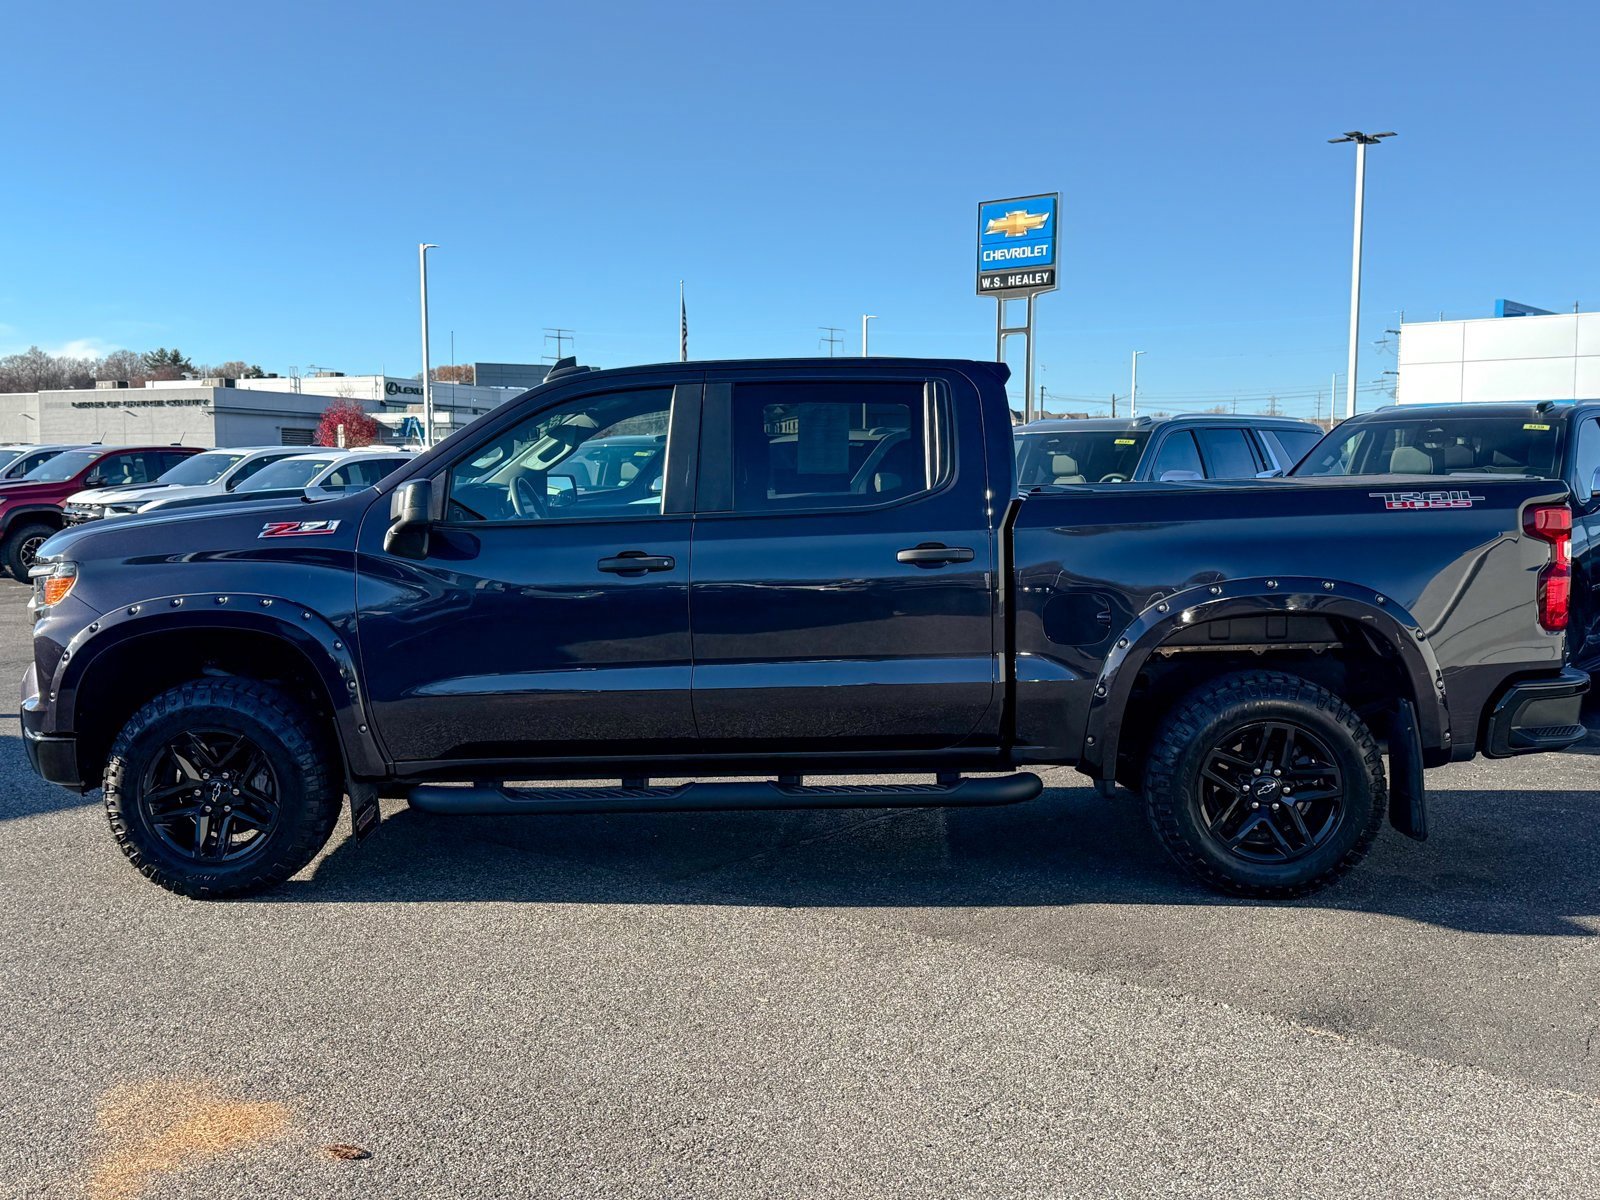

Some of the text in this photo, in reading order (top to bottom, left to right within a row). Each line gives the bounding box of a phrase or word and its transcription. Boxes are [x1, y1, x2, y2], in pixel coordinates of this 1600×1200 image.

[983, 245, 1048, 261] CHEVROLET
[982, 272, 1049, 288] W.S. HEALEY
[1369, 491, 1485, 501] TRAIL
[1386, 500, 1472, 509] BOSS
[257, 519, 342, 538] Z71
